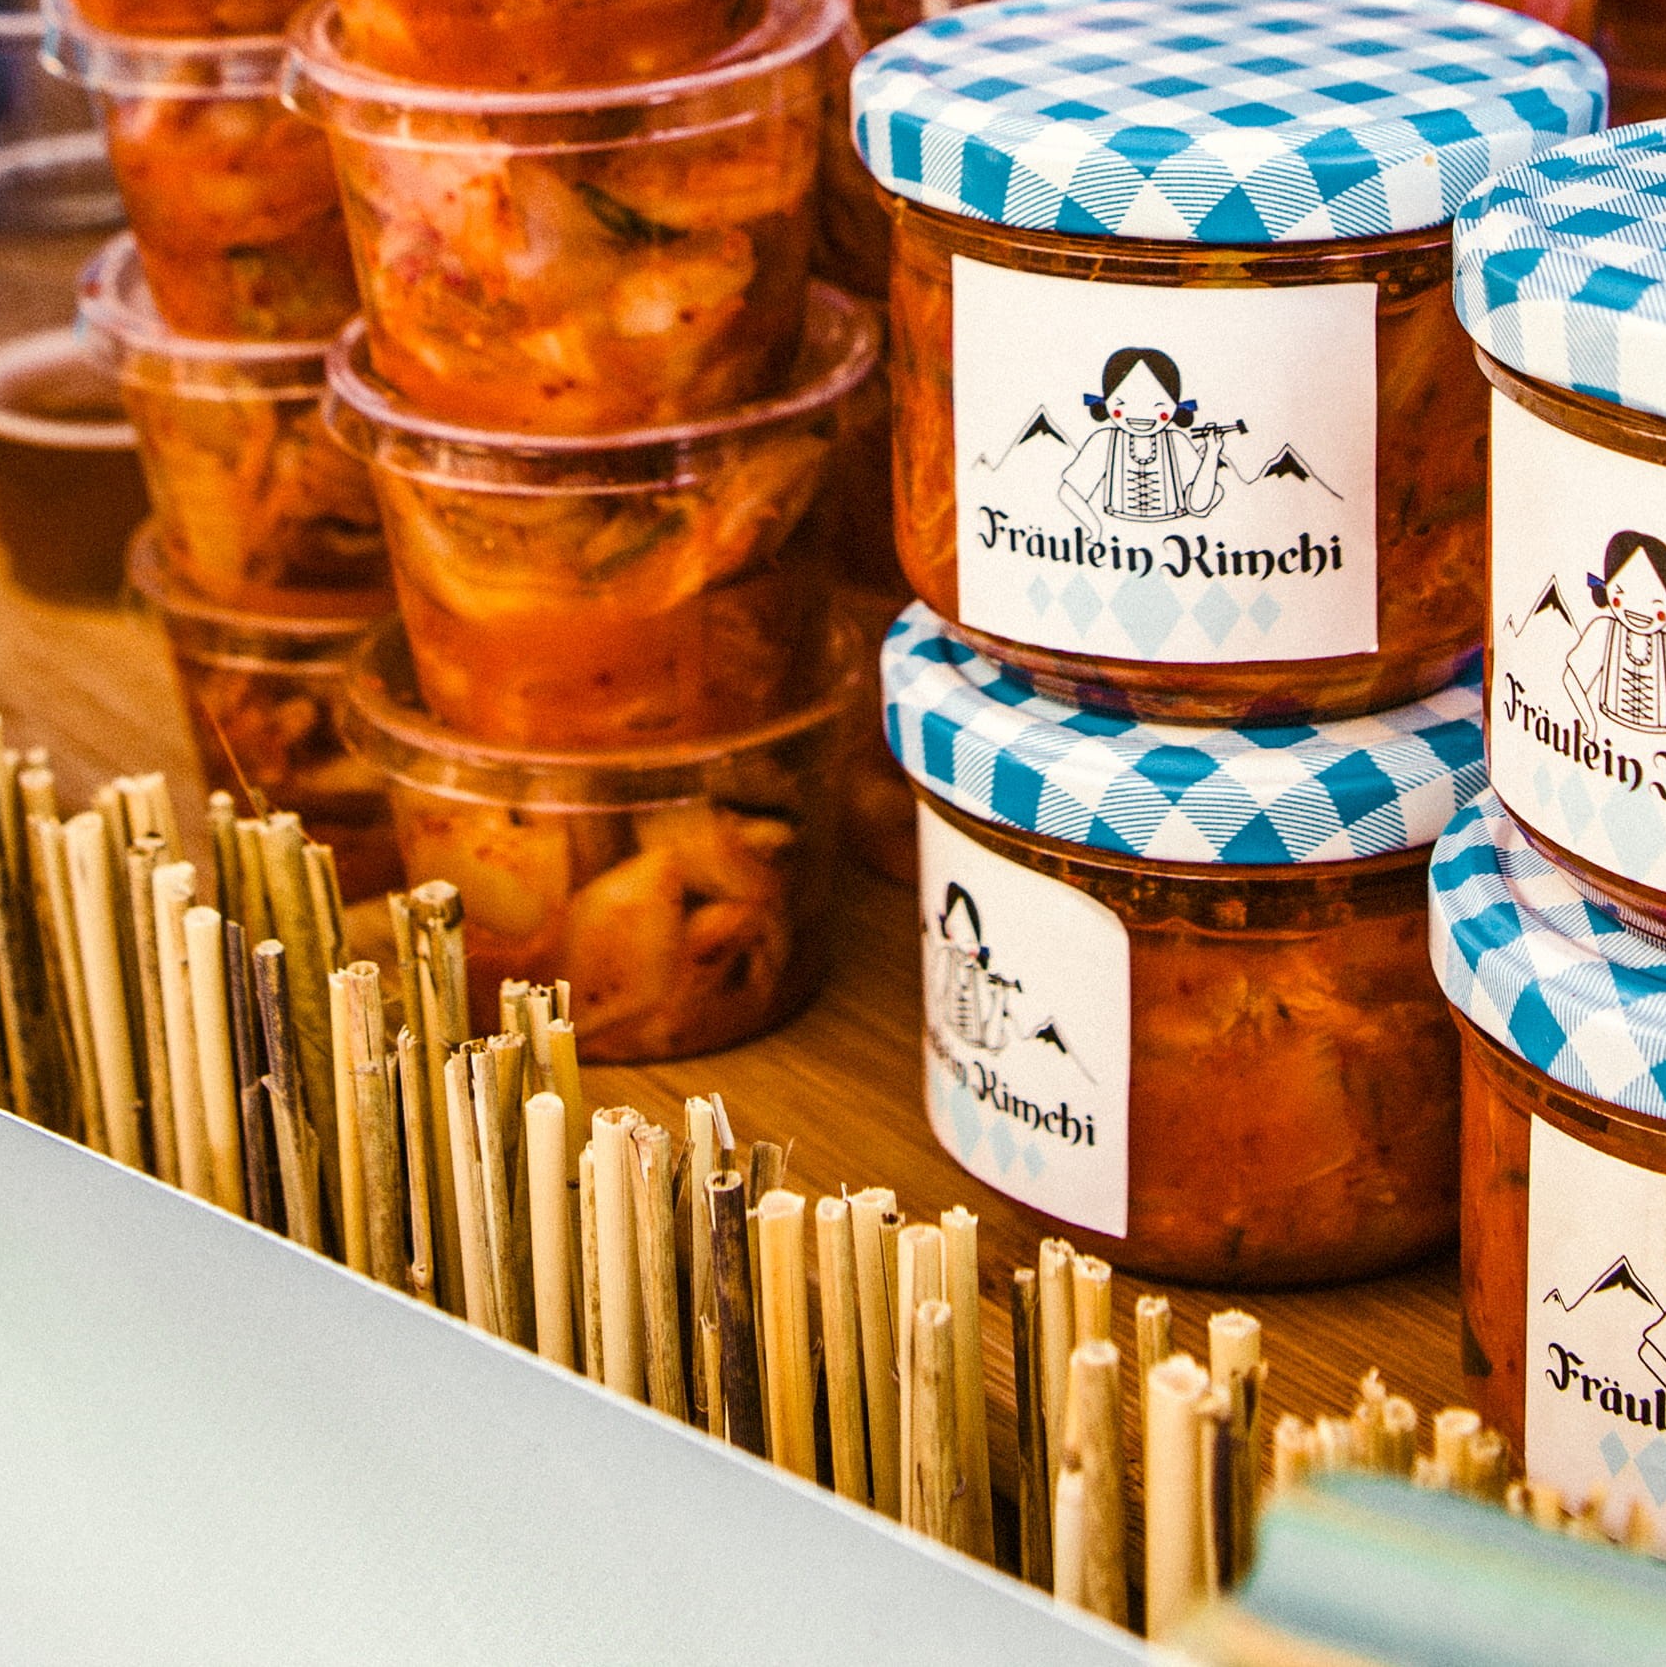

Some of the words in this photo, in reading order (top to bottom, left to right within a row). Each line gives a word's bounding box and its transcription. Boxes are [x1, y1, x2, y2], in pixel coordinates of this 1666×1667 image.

[979, 505, 1154, 578] Fräulein
[1161, 532, 1344, 581] Kimchi
[1504, 672, 1644, 792] Fräulein
[973, 1060, 1095, 1146] Kimchi
